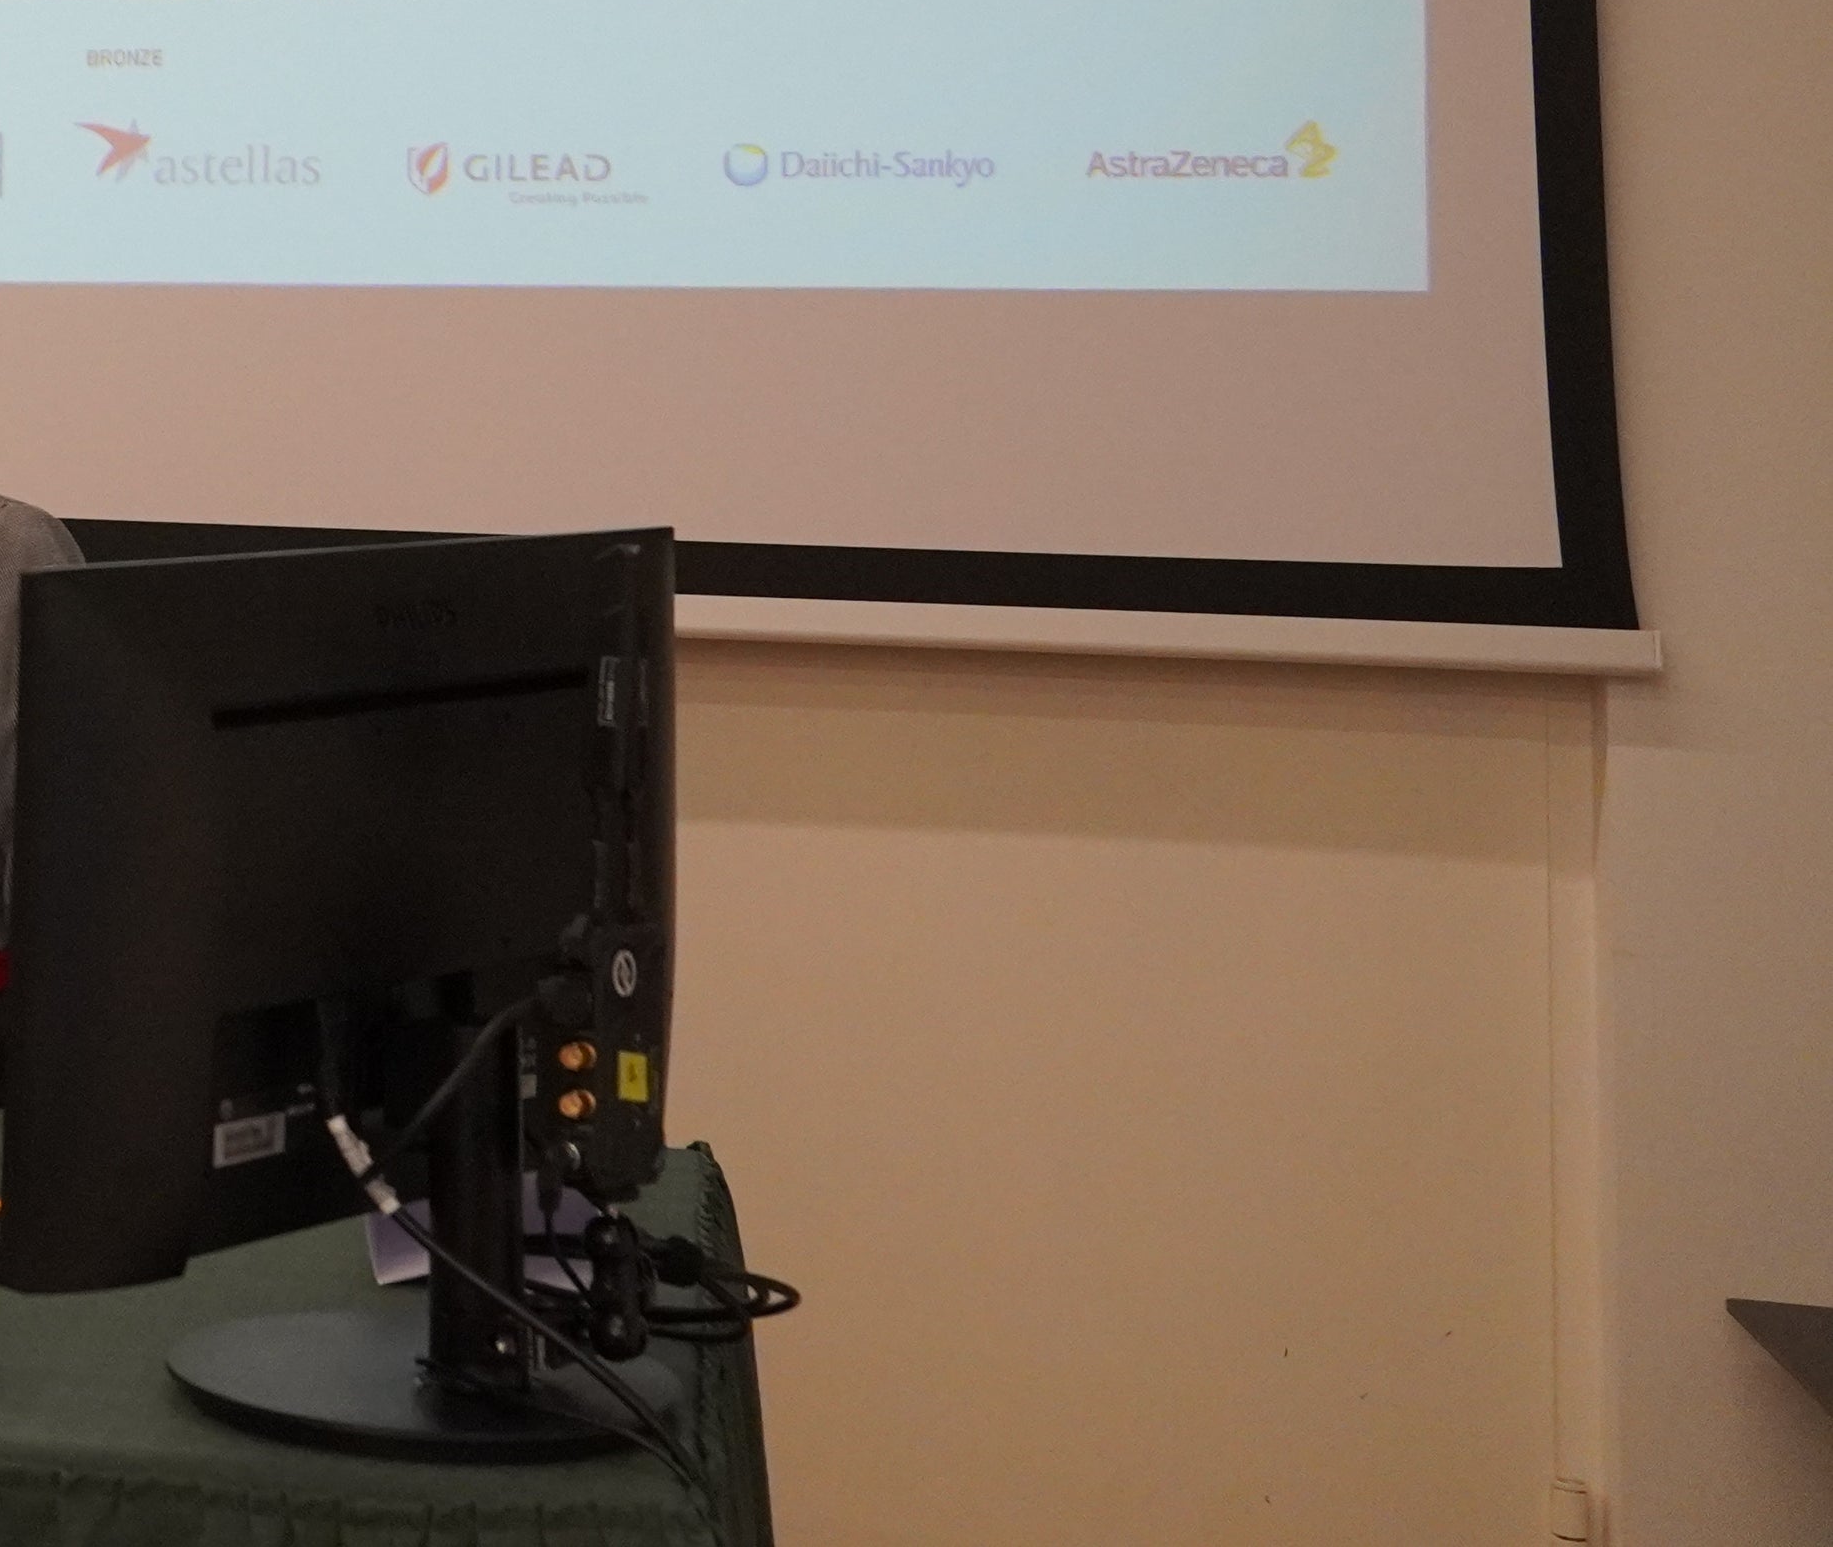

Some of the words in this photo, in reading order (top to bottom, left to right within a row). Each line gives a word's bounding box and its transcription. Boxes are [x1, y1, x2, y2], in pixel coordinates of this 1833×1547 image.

[87, 49, 163, 66] BRONZE
[154, 145, 322, 186] astellas
[464, 153, 611, 182] GILEAD
[781, 149, 995, 187] Daiichi-Sankyo
[1086, 150, 1290, 179] AstraZeneca
